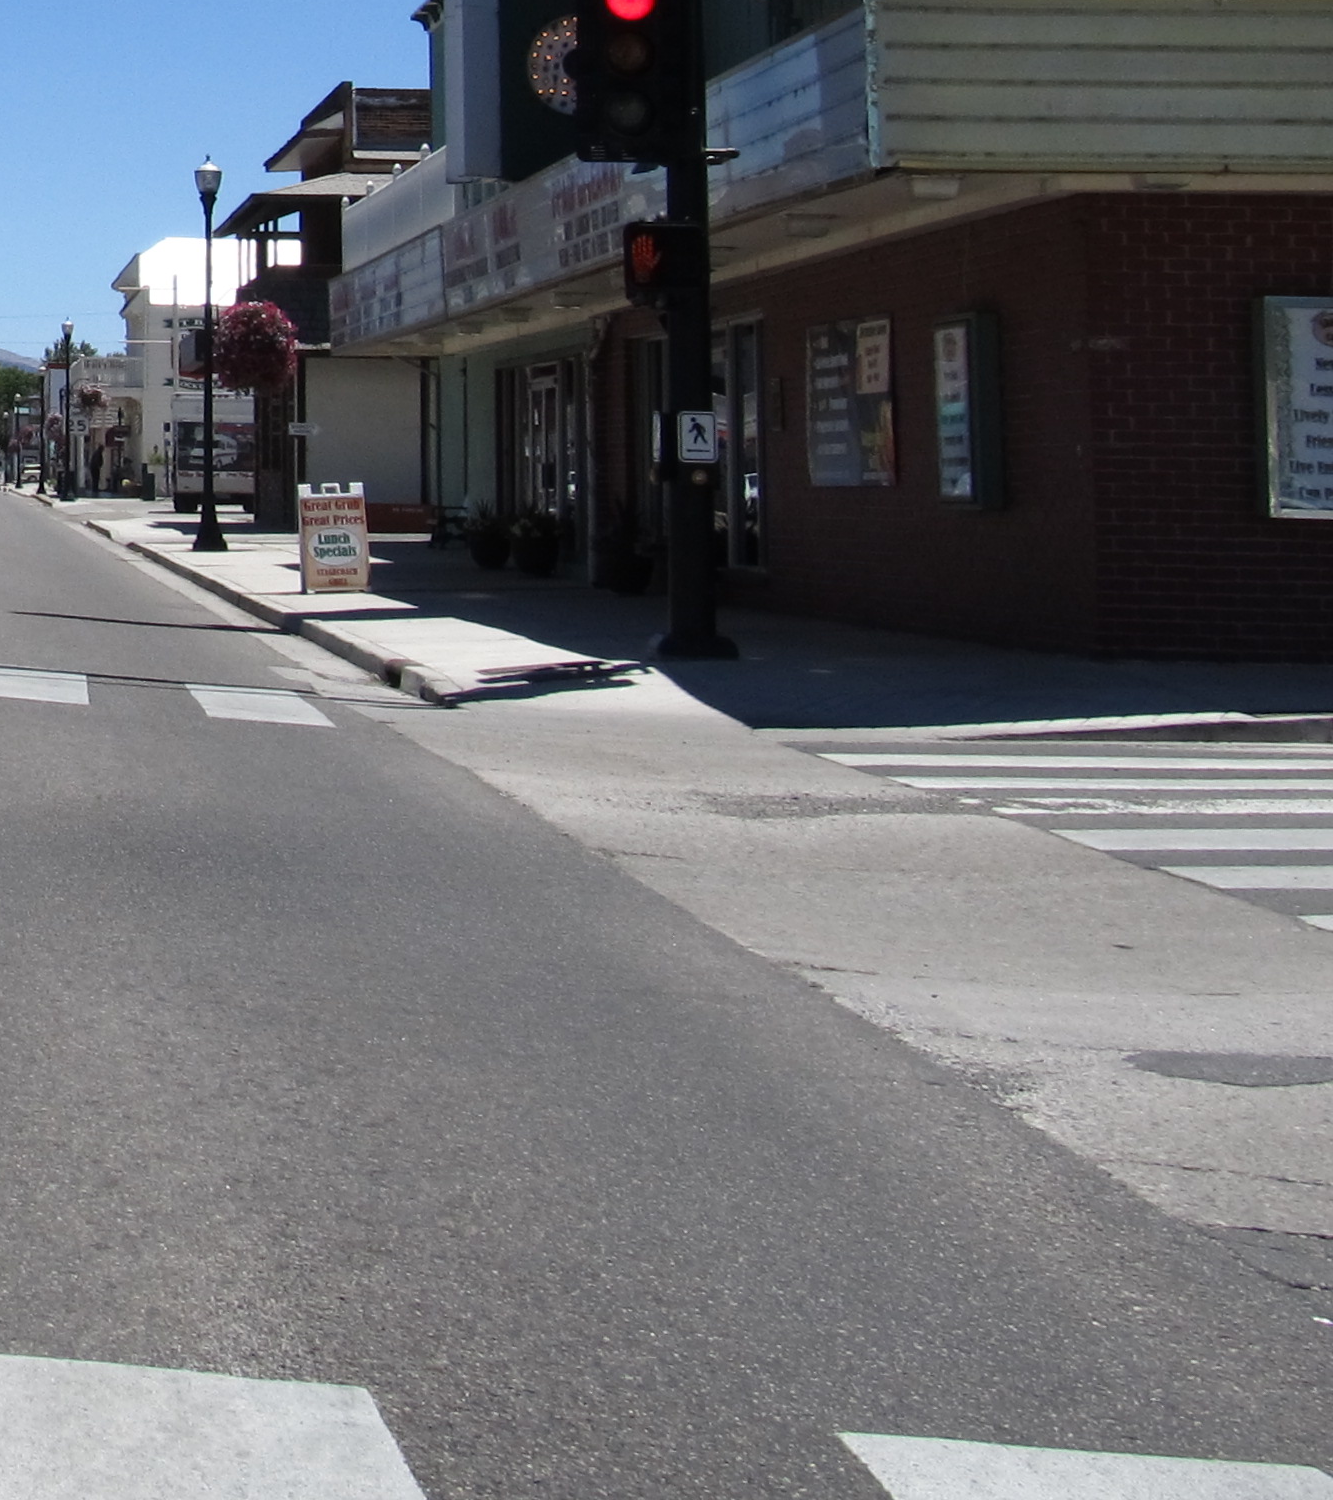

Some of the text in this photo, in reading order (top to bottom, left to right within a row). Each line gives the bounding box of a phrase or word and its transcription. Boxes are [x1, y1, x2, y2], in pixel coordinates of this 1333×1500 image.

[68, 419, 87, 432] 25
[303, 501, 331, 512] Great
[302, 514, 365, 526] Great Prices
[318, 532, 351, 545] Lunch
[314, 545, 358, 559] Specials
